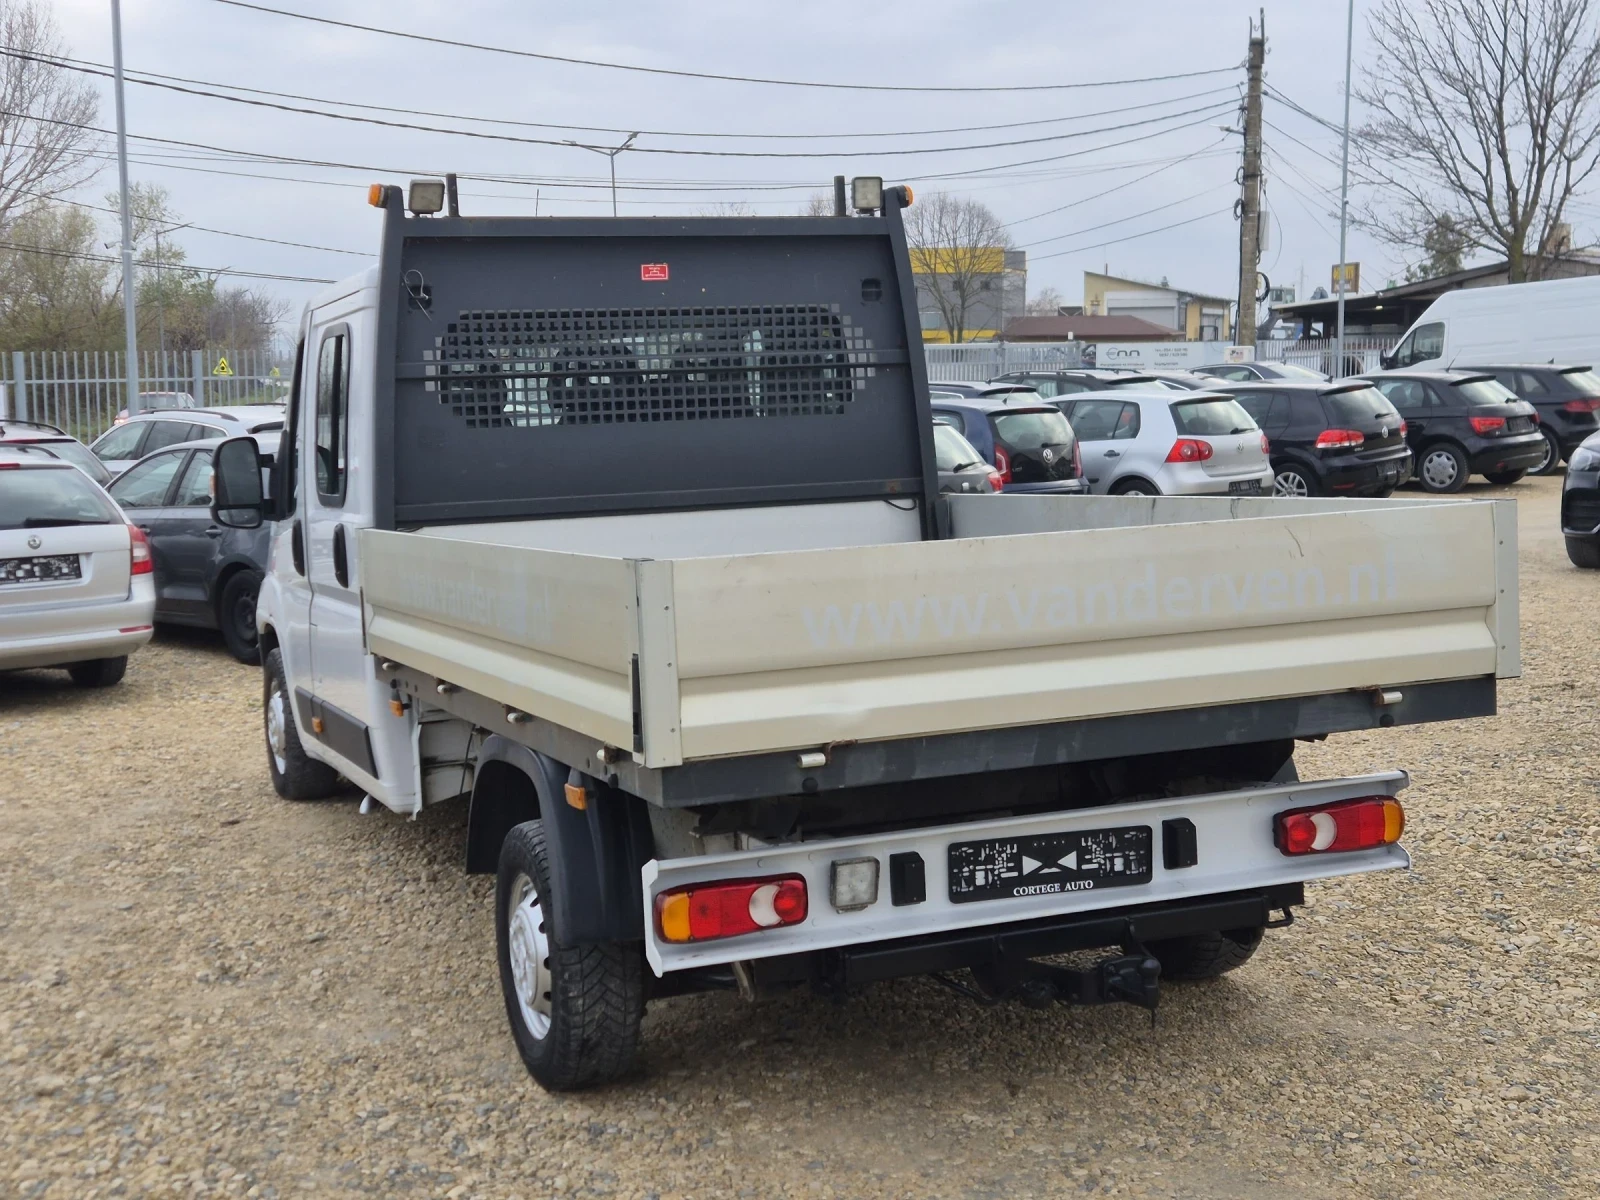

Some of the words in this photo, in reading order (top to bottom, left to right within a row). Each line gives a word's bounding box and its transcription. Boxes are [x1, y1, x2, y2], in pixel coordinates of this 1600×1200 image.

[801, 554, 1399, 649] www.vanderven.nl
[1013, 883, 1061, 896] CORTEGE
[1064, 880, 1094, 891] AUTO
